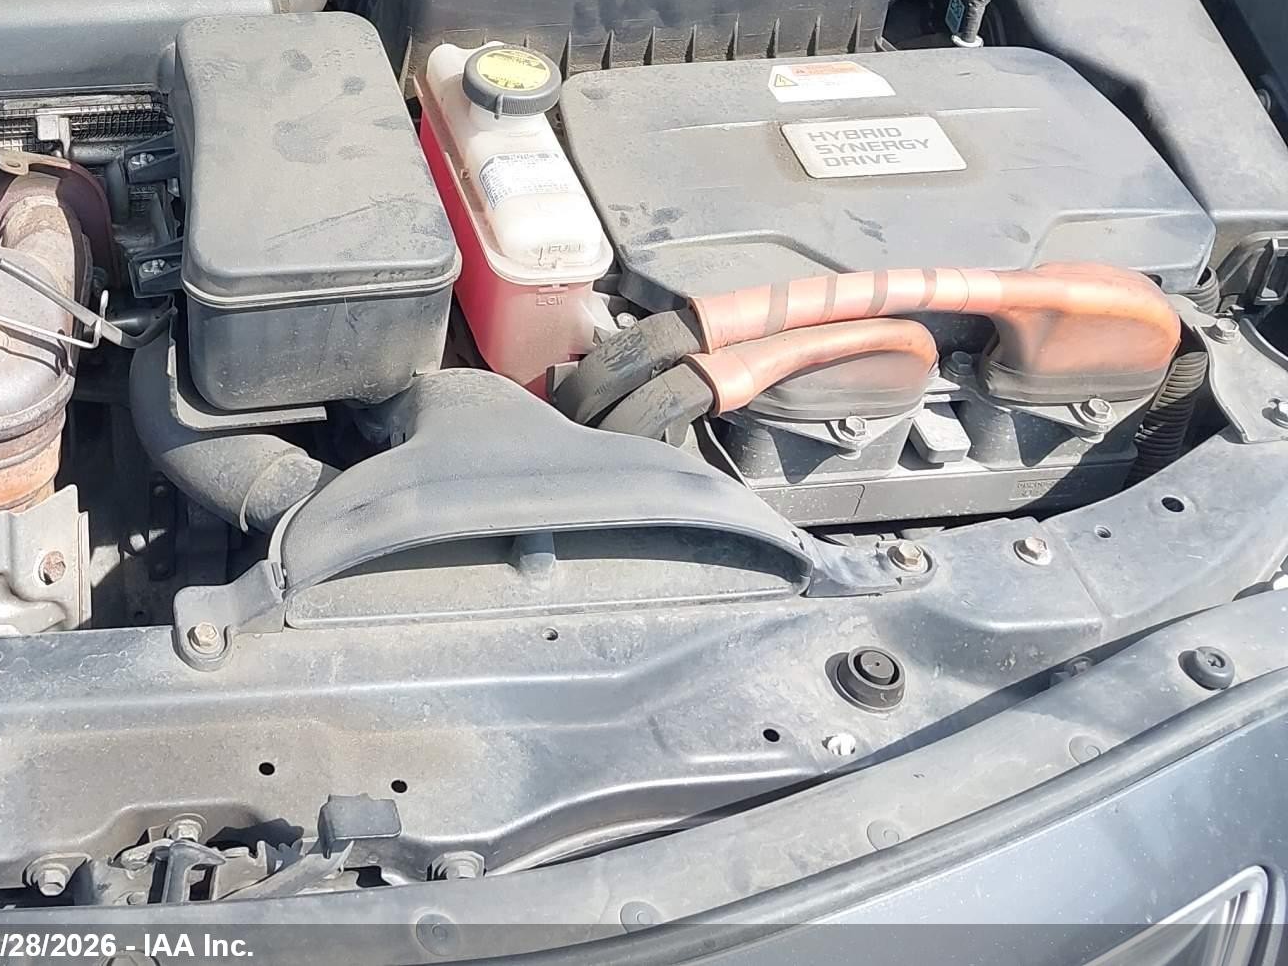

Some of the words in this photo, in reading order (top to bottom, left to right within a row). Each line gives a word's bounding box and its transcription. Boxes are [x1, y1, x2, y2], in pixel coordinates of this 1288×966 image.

[808, 127, 902, 142] HYBRID
[815, 138, 929, 155] SYNERGY
[823, 153, 901, 167] DRIVE
